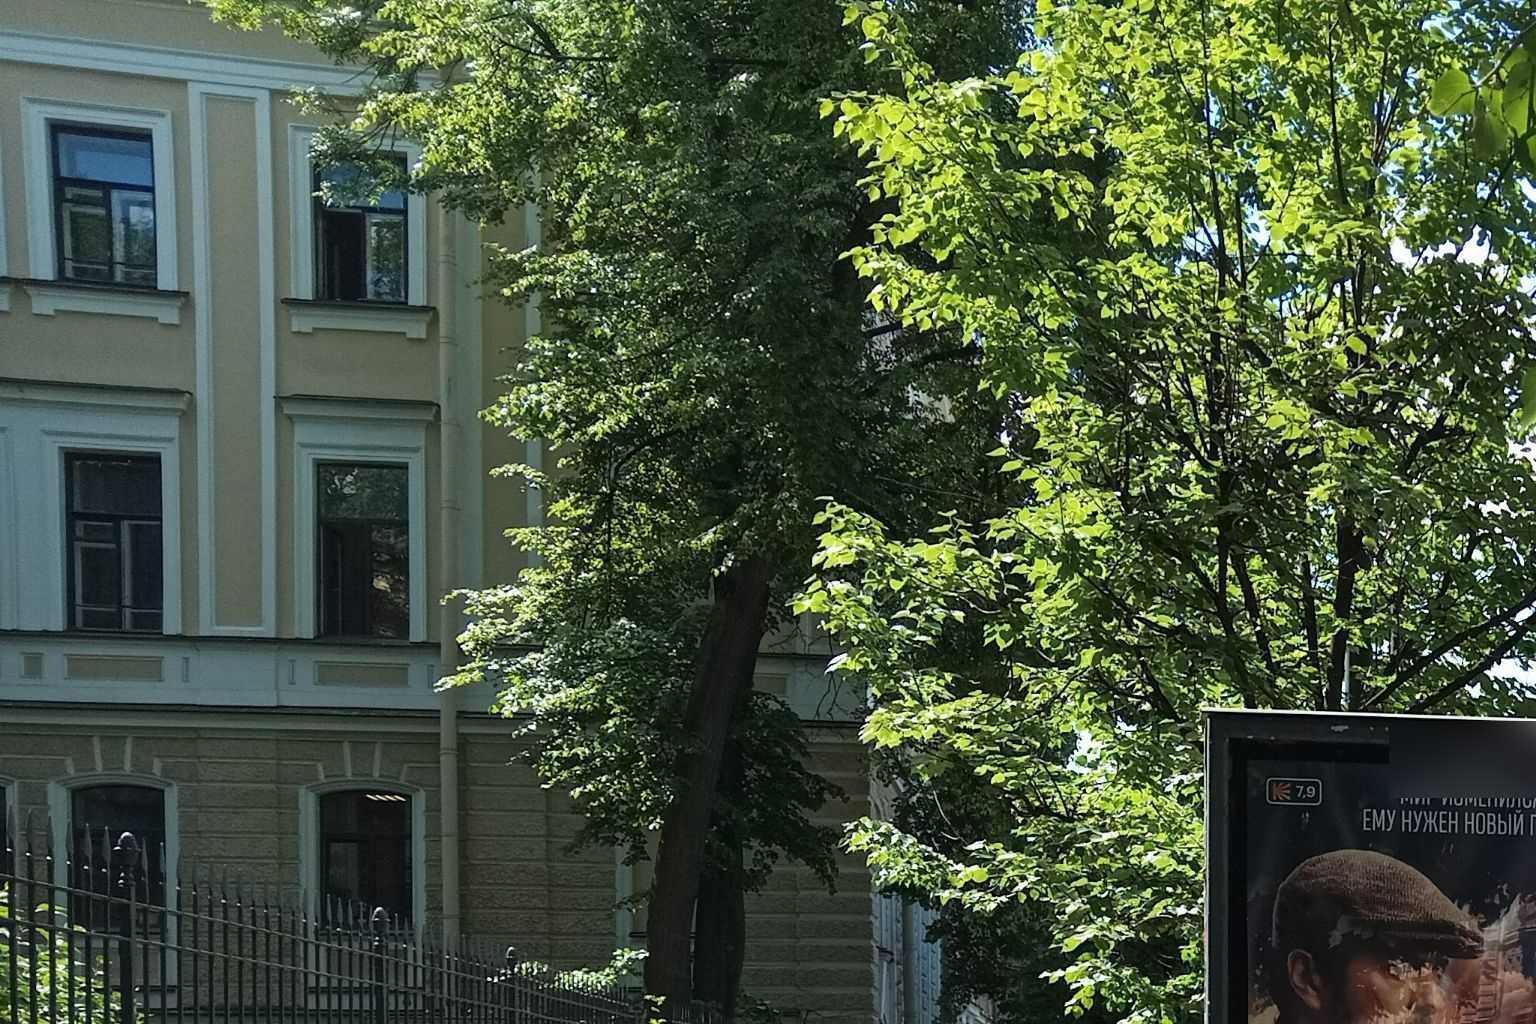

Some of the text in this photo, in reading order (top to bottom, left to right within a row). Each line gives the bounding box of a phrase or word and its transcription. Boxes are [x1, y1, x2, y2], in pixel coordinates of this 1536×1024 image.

[1296, 785, 1316, 799] 7,9
[1363, 811, 1396, 832] ЕМУ
[1402, 810, 1458, 833] НУЖЕН
[1465, 809, 1524, 835] НОВЫЙ
